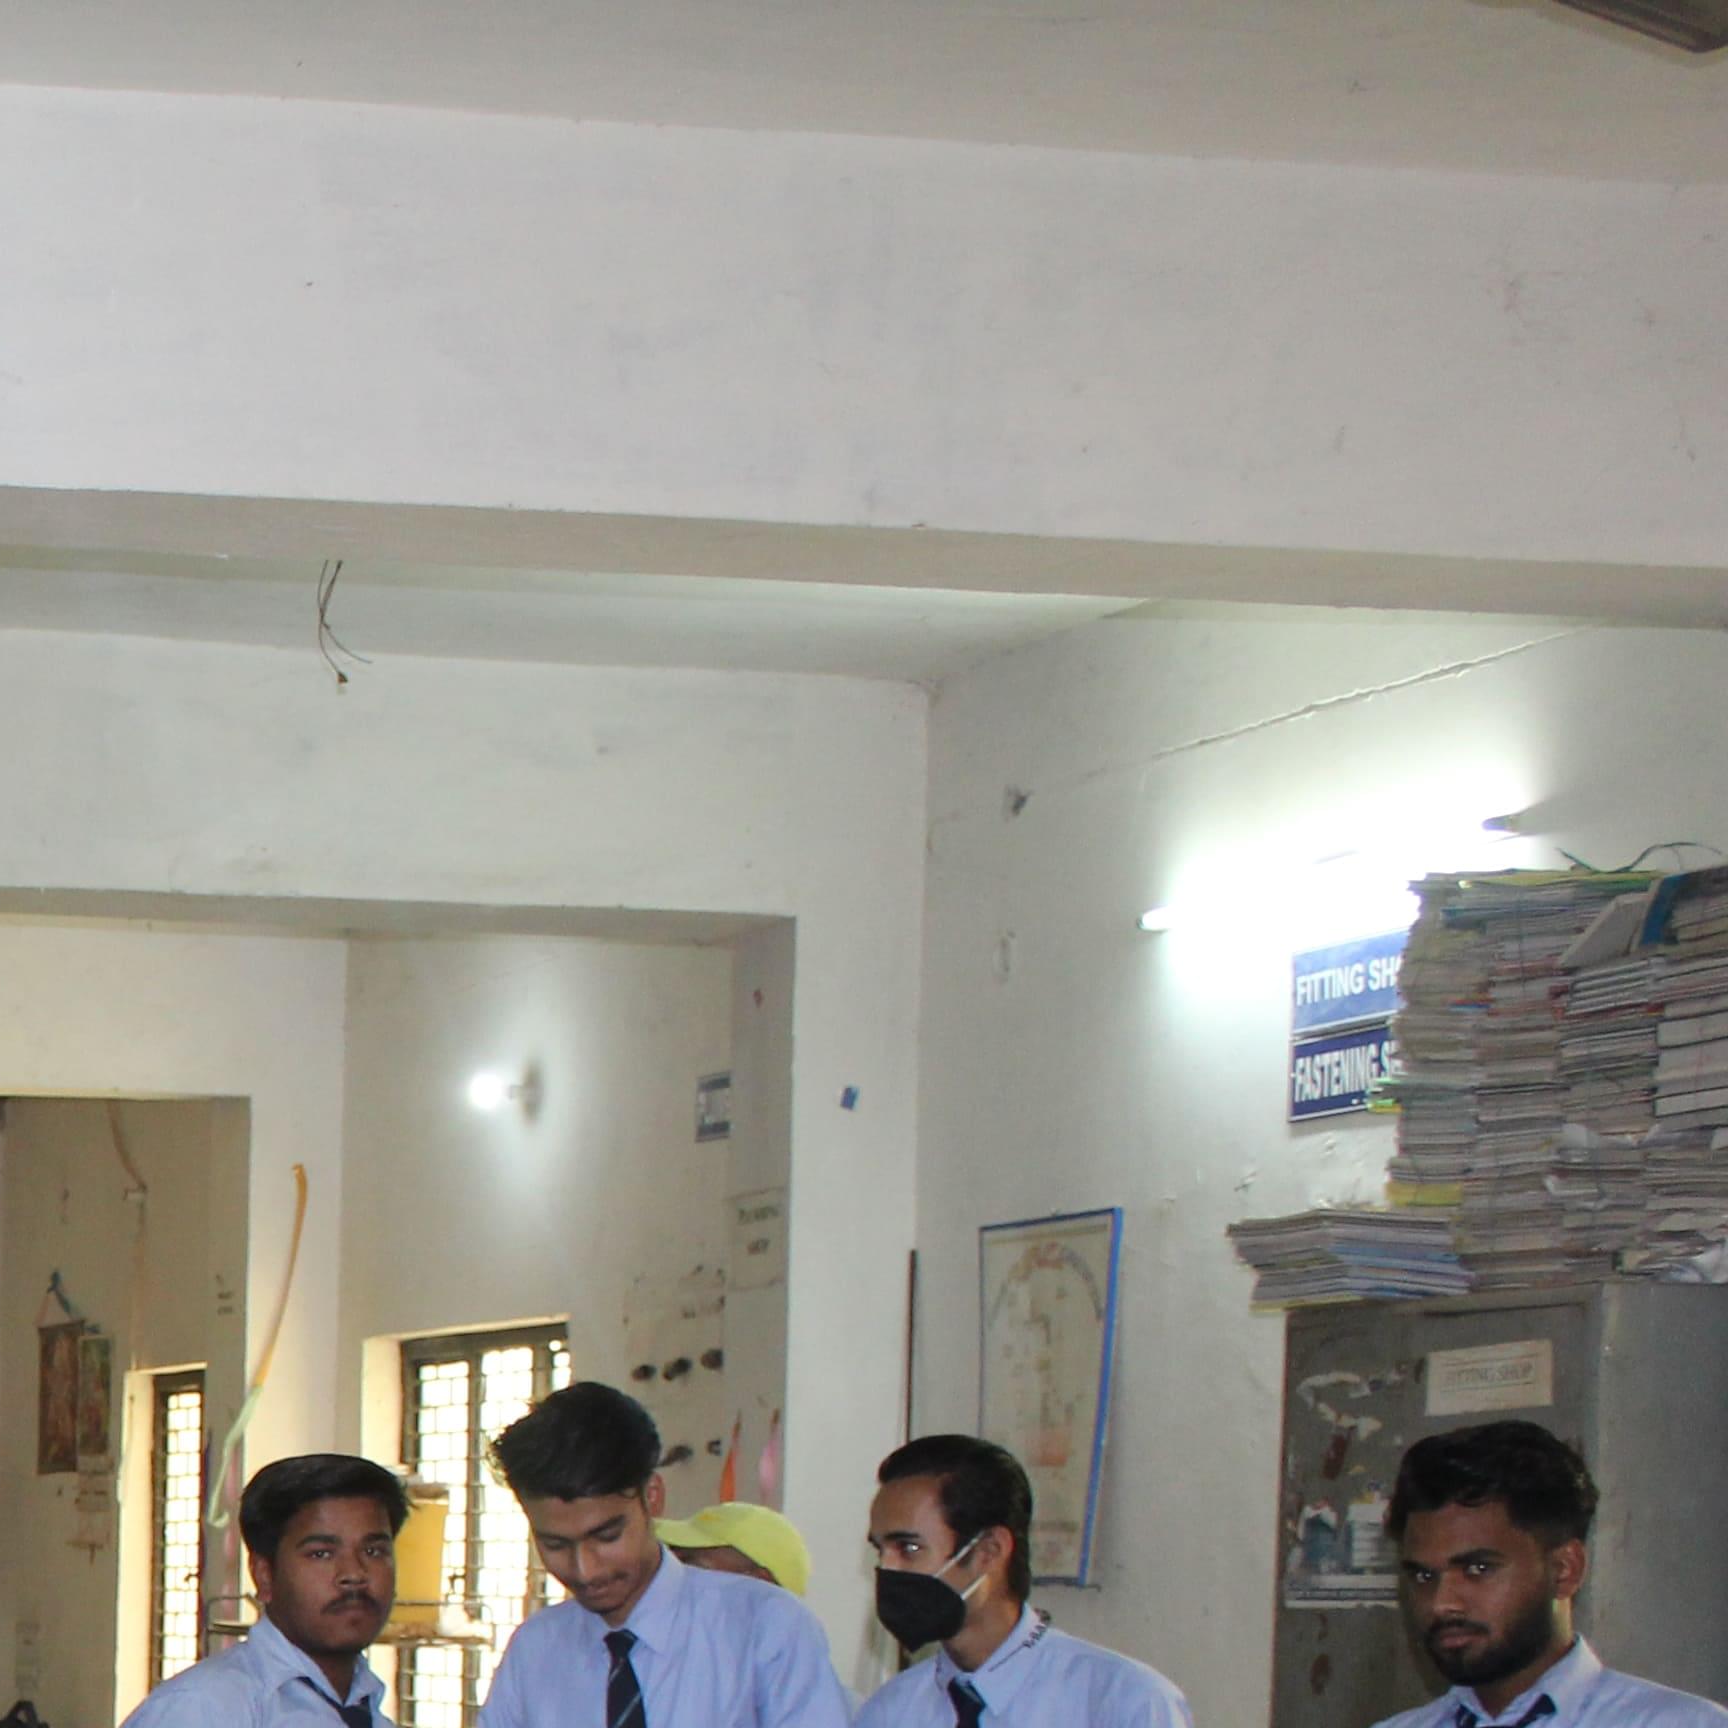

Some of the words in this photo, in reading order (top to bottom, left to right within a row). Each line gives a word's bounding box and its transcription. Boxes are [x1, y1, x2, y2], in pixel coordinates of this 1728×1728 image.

[1296, 962, 1365, 1006] FITTING
[1368, 957, 1403, 992] SH
[1294, 1044, 1378, 1102] FASTENING
